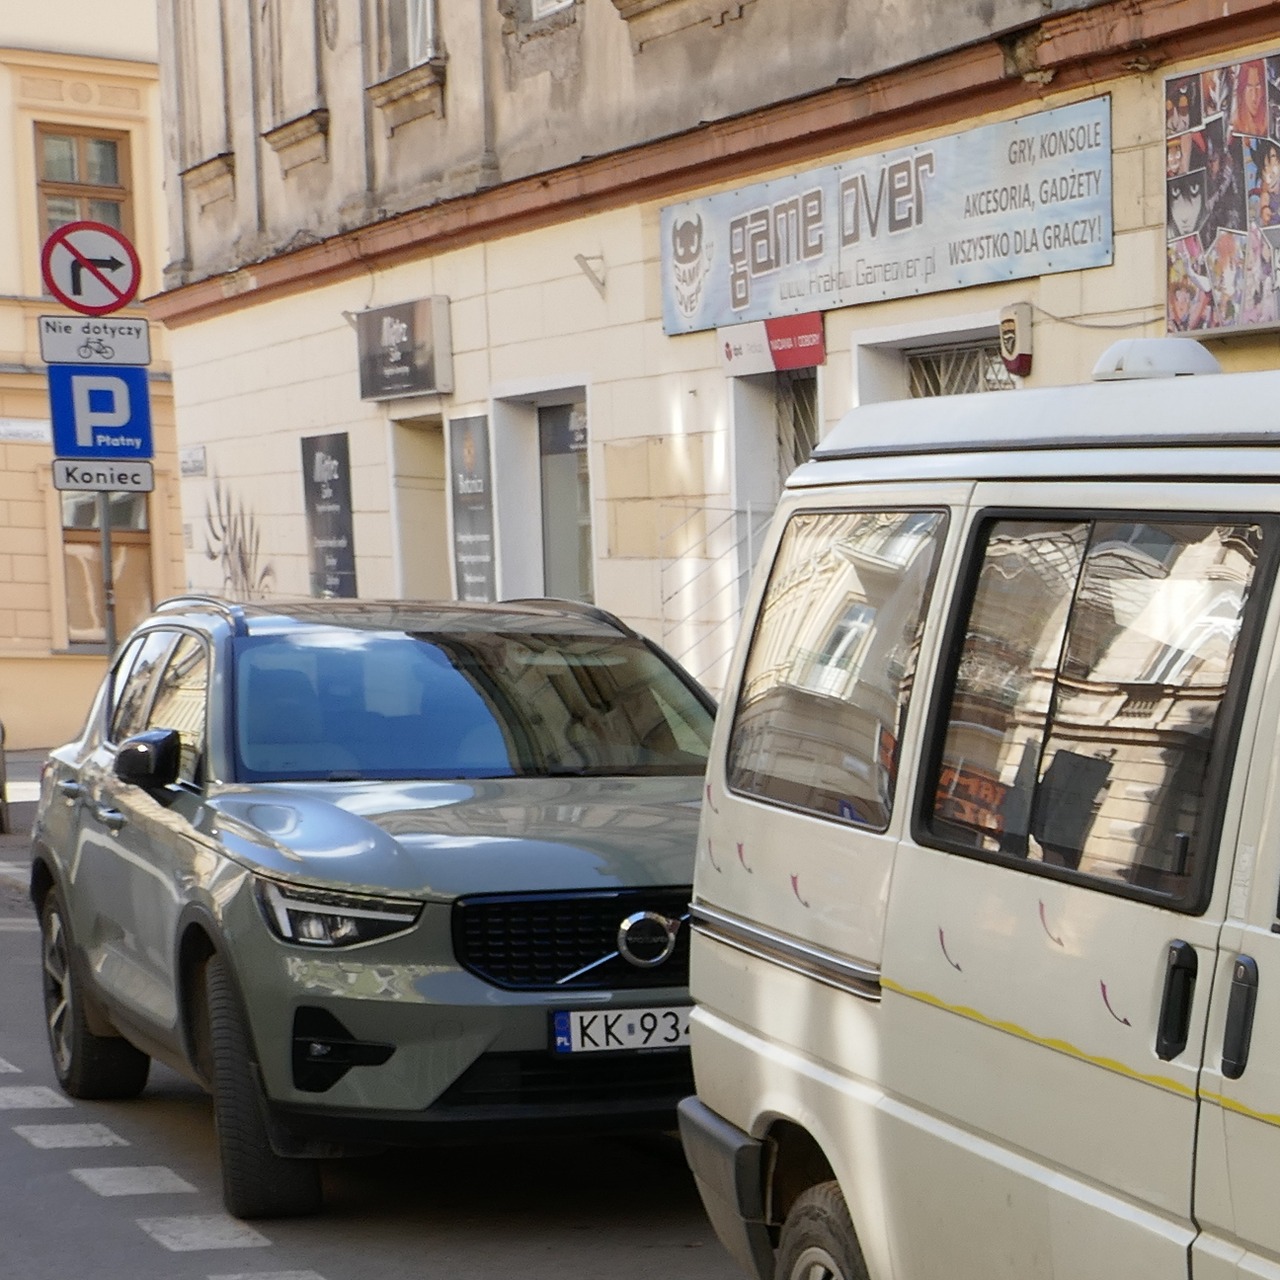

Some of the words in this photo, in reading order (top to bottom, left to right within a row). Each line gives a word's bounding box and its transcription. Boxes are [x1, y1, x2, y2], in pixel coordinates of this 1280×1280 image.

[1008, 137, 1036, 165] GRY,
[1040, 122, 1101, 159] KONSOLE
[964, 183, 1035, 219] AKCESORIA,
[1039, 168, 1102, 205] GADŻETY
[949, 233, 1010, 266] WSZYSTKO
[1014, 228, 1039, 255] DLA
[1043, 215, 1102, 250] GRACZY!
[674, 263, 701, 287] GAME
[45, 321, 72, 334] Nie
[81, 322, 142, 339] dotyczy
[71, 375, 131, 447] P
[64, 467, 141, 485] Koniec
[557, 1037, 570, 1046] PL
[579, 1013, 624, 1048] KK
[640, 1011, 690, 1045] 93
